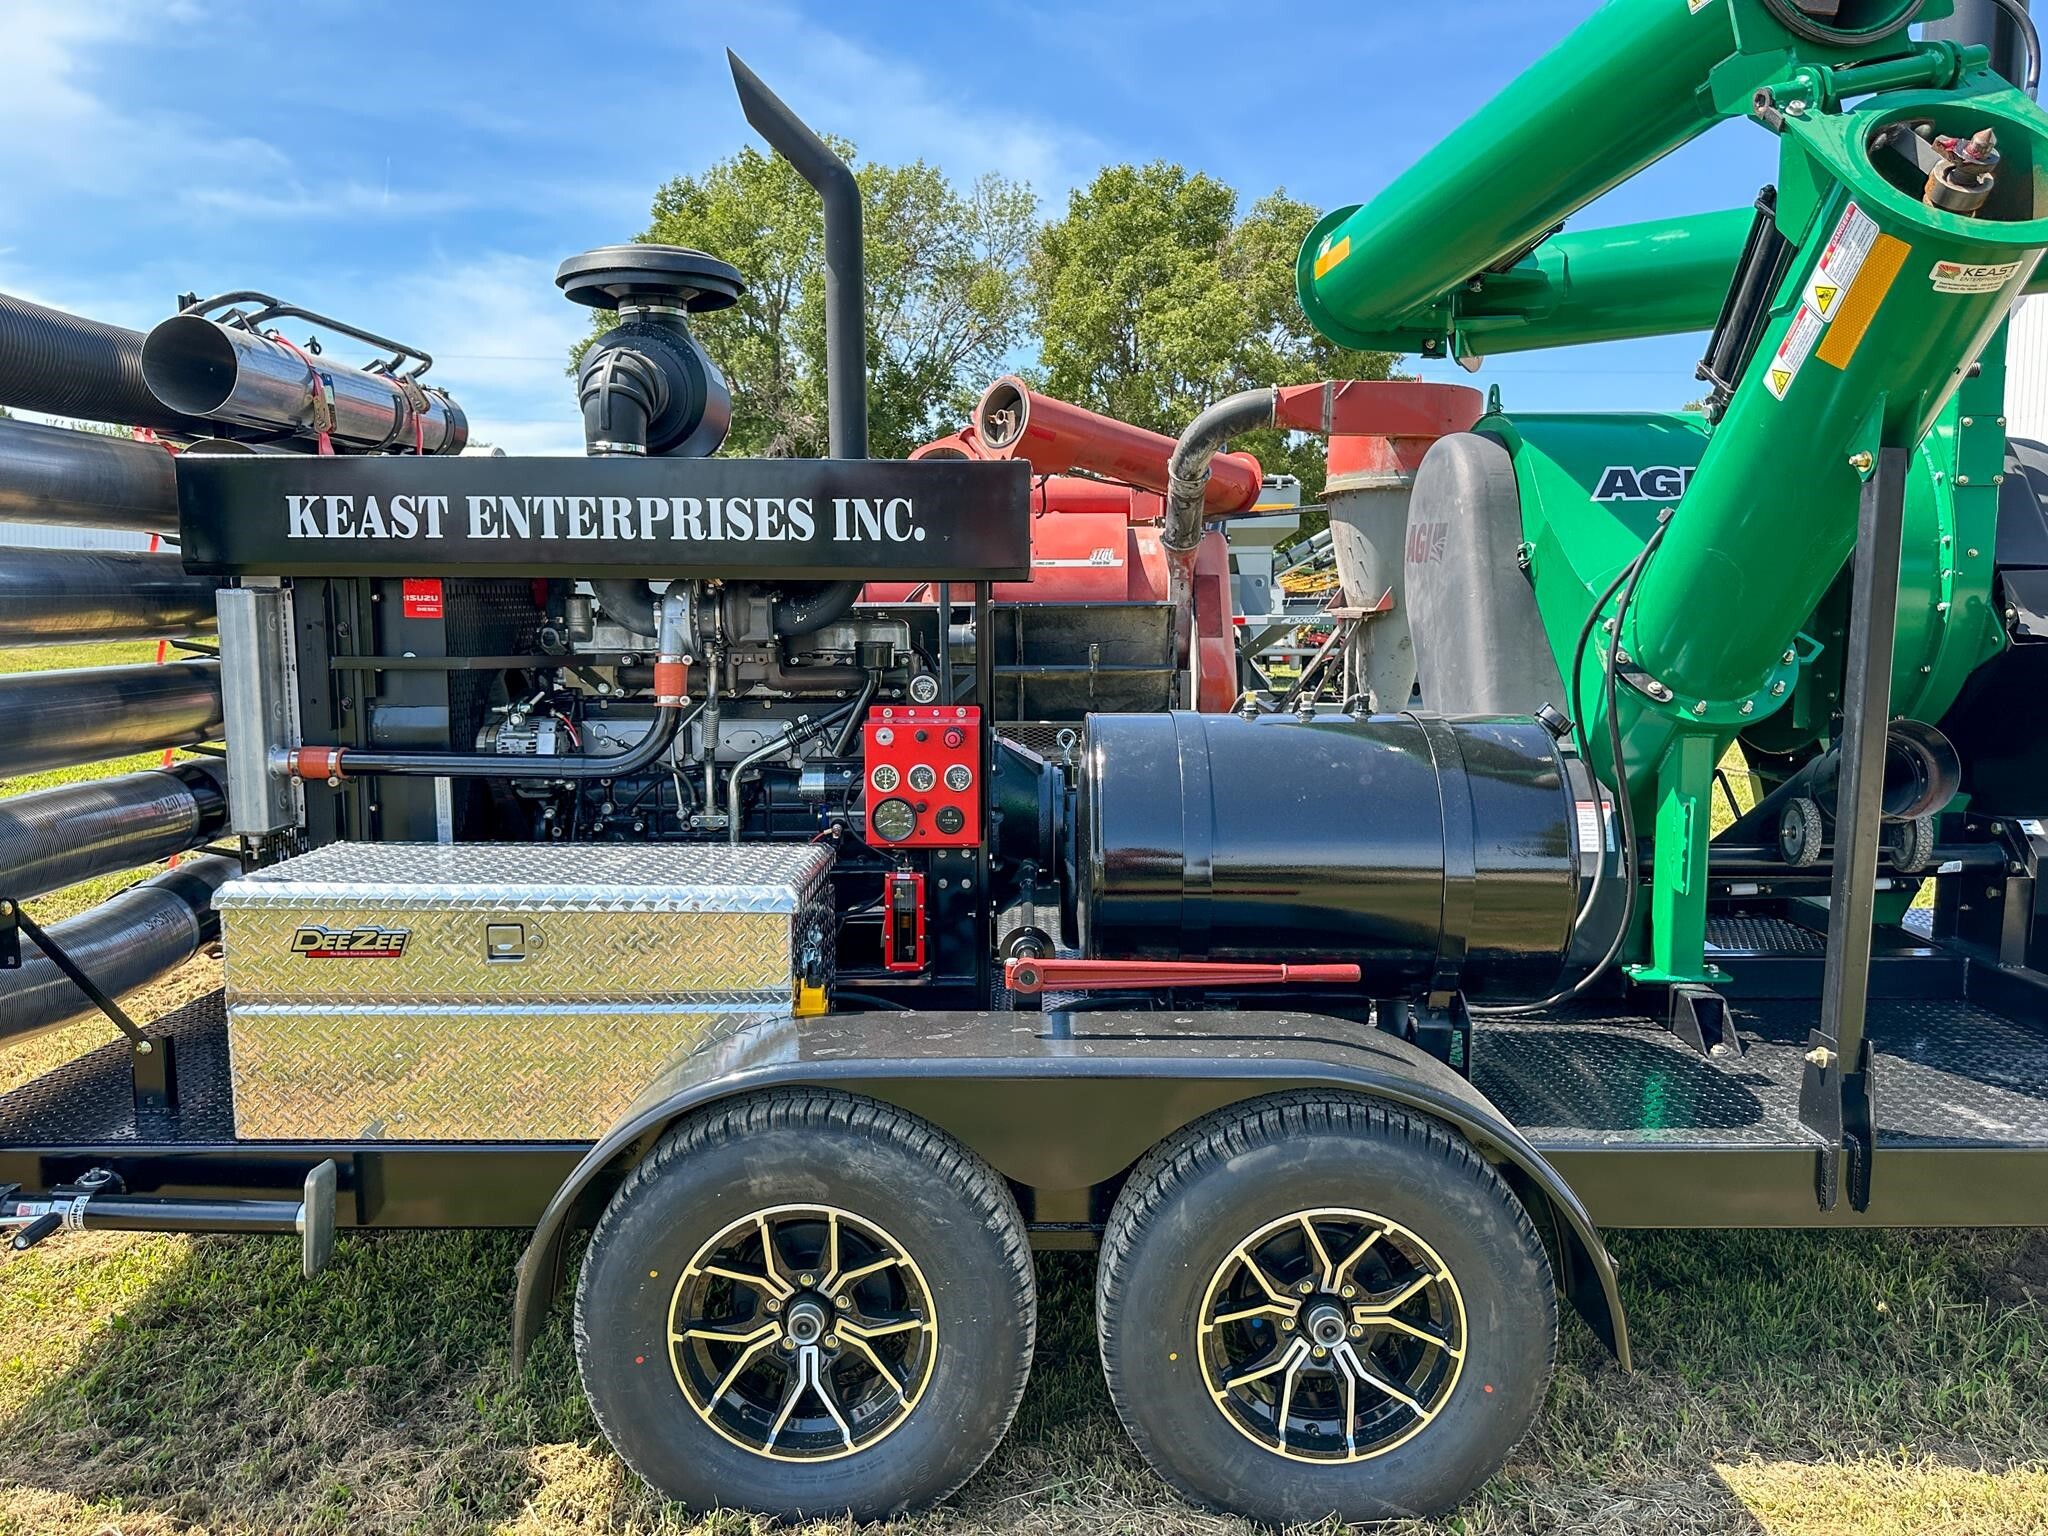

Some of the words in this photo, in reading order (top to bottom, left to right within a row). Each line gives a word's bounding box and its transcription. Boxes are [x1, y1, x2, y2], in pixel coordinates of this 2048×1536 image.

[1831, 213, 1852, 247] DANGER
[1963, 264, 2019, 277] KEAST
[285, 495, 449, 539] KEAST
[465, 496, 815, 541] ENTERPRISES
[832, 498, 926, 542] INC.
[406, 594, 439, 602] ISUZU
